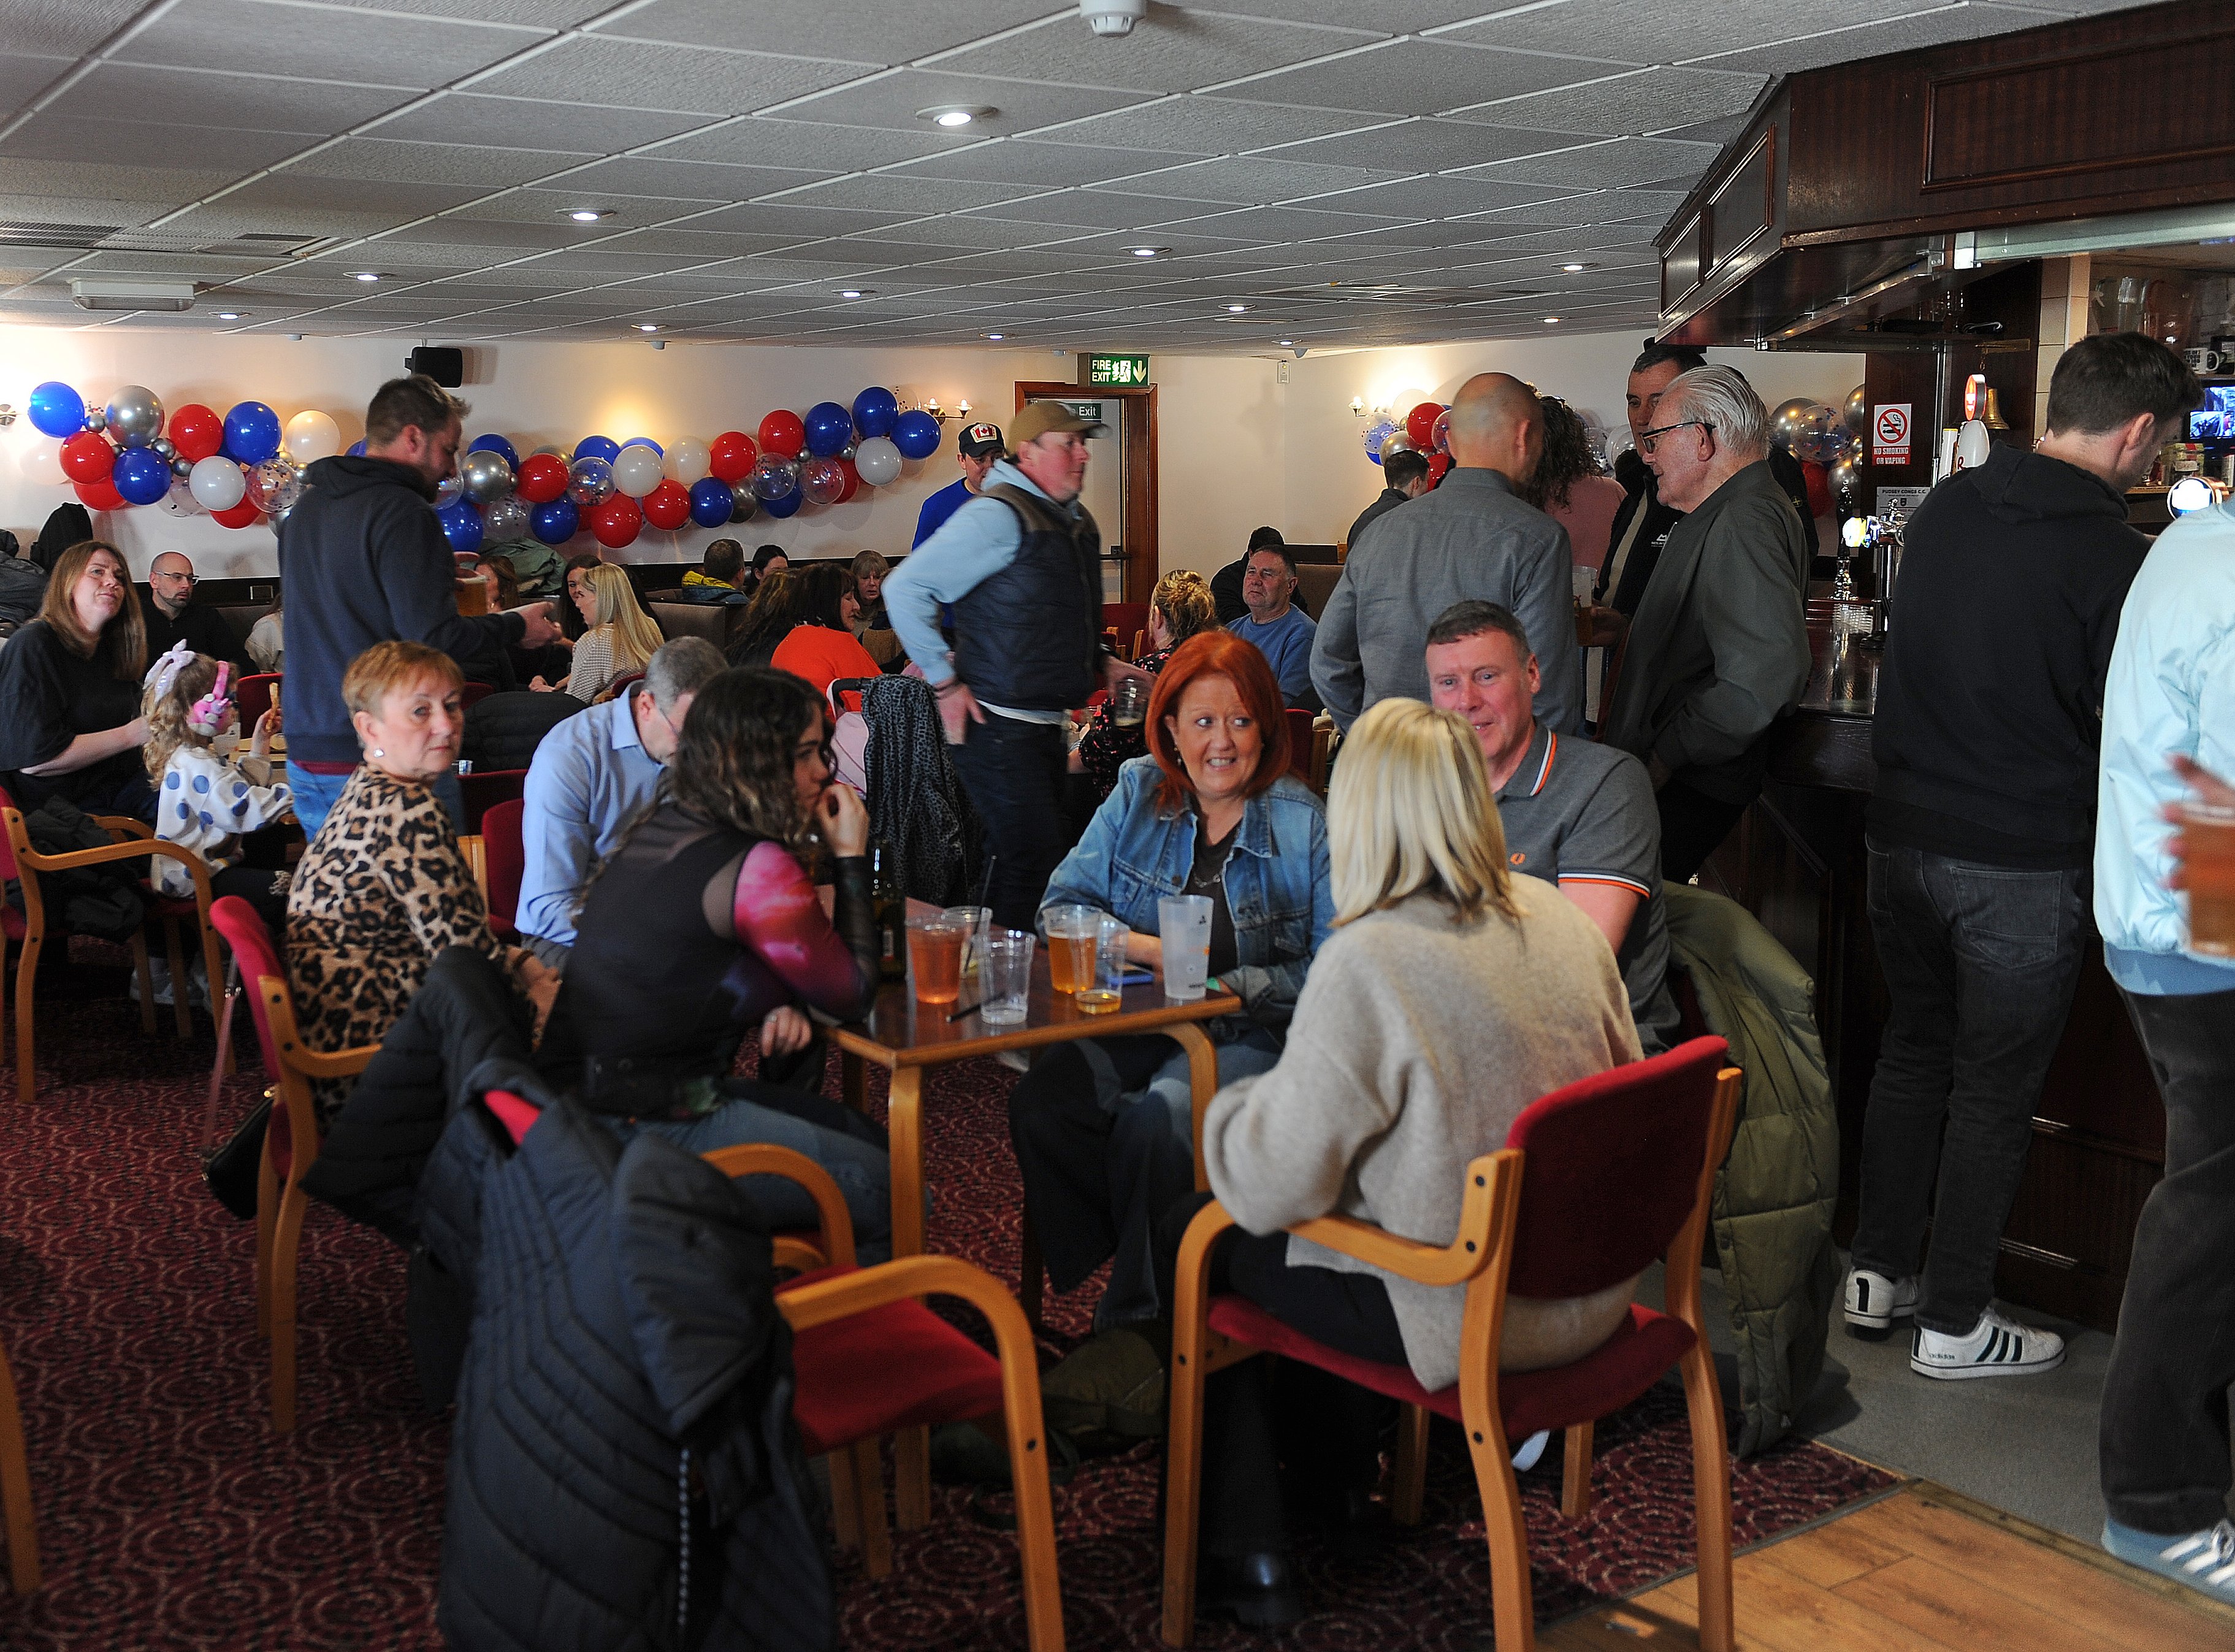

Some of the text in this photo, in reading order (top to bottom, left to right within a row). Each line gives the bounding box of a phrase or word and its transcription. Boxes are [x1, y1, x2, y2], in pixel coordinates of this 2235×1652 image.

[1092, 359, 1112, 370] FIRE
[1092, 372, 1111, 382] EXIT
[1079, 406, 1096, 416] Exit
